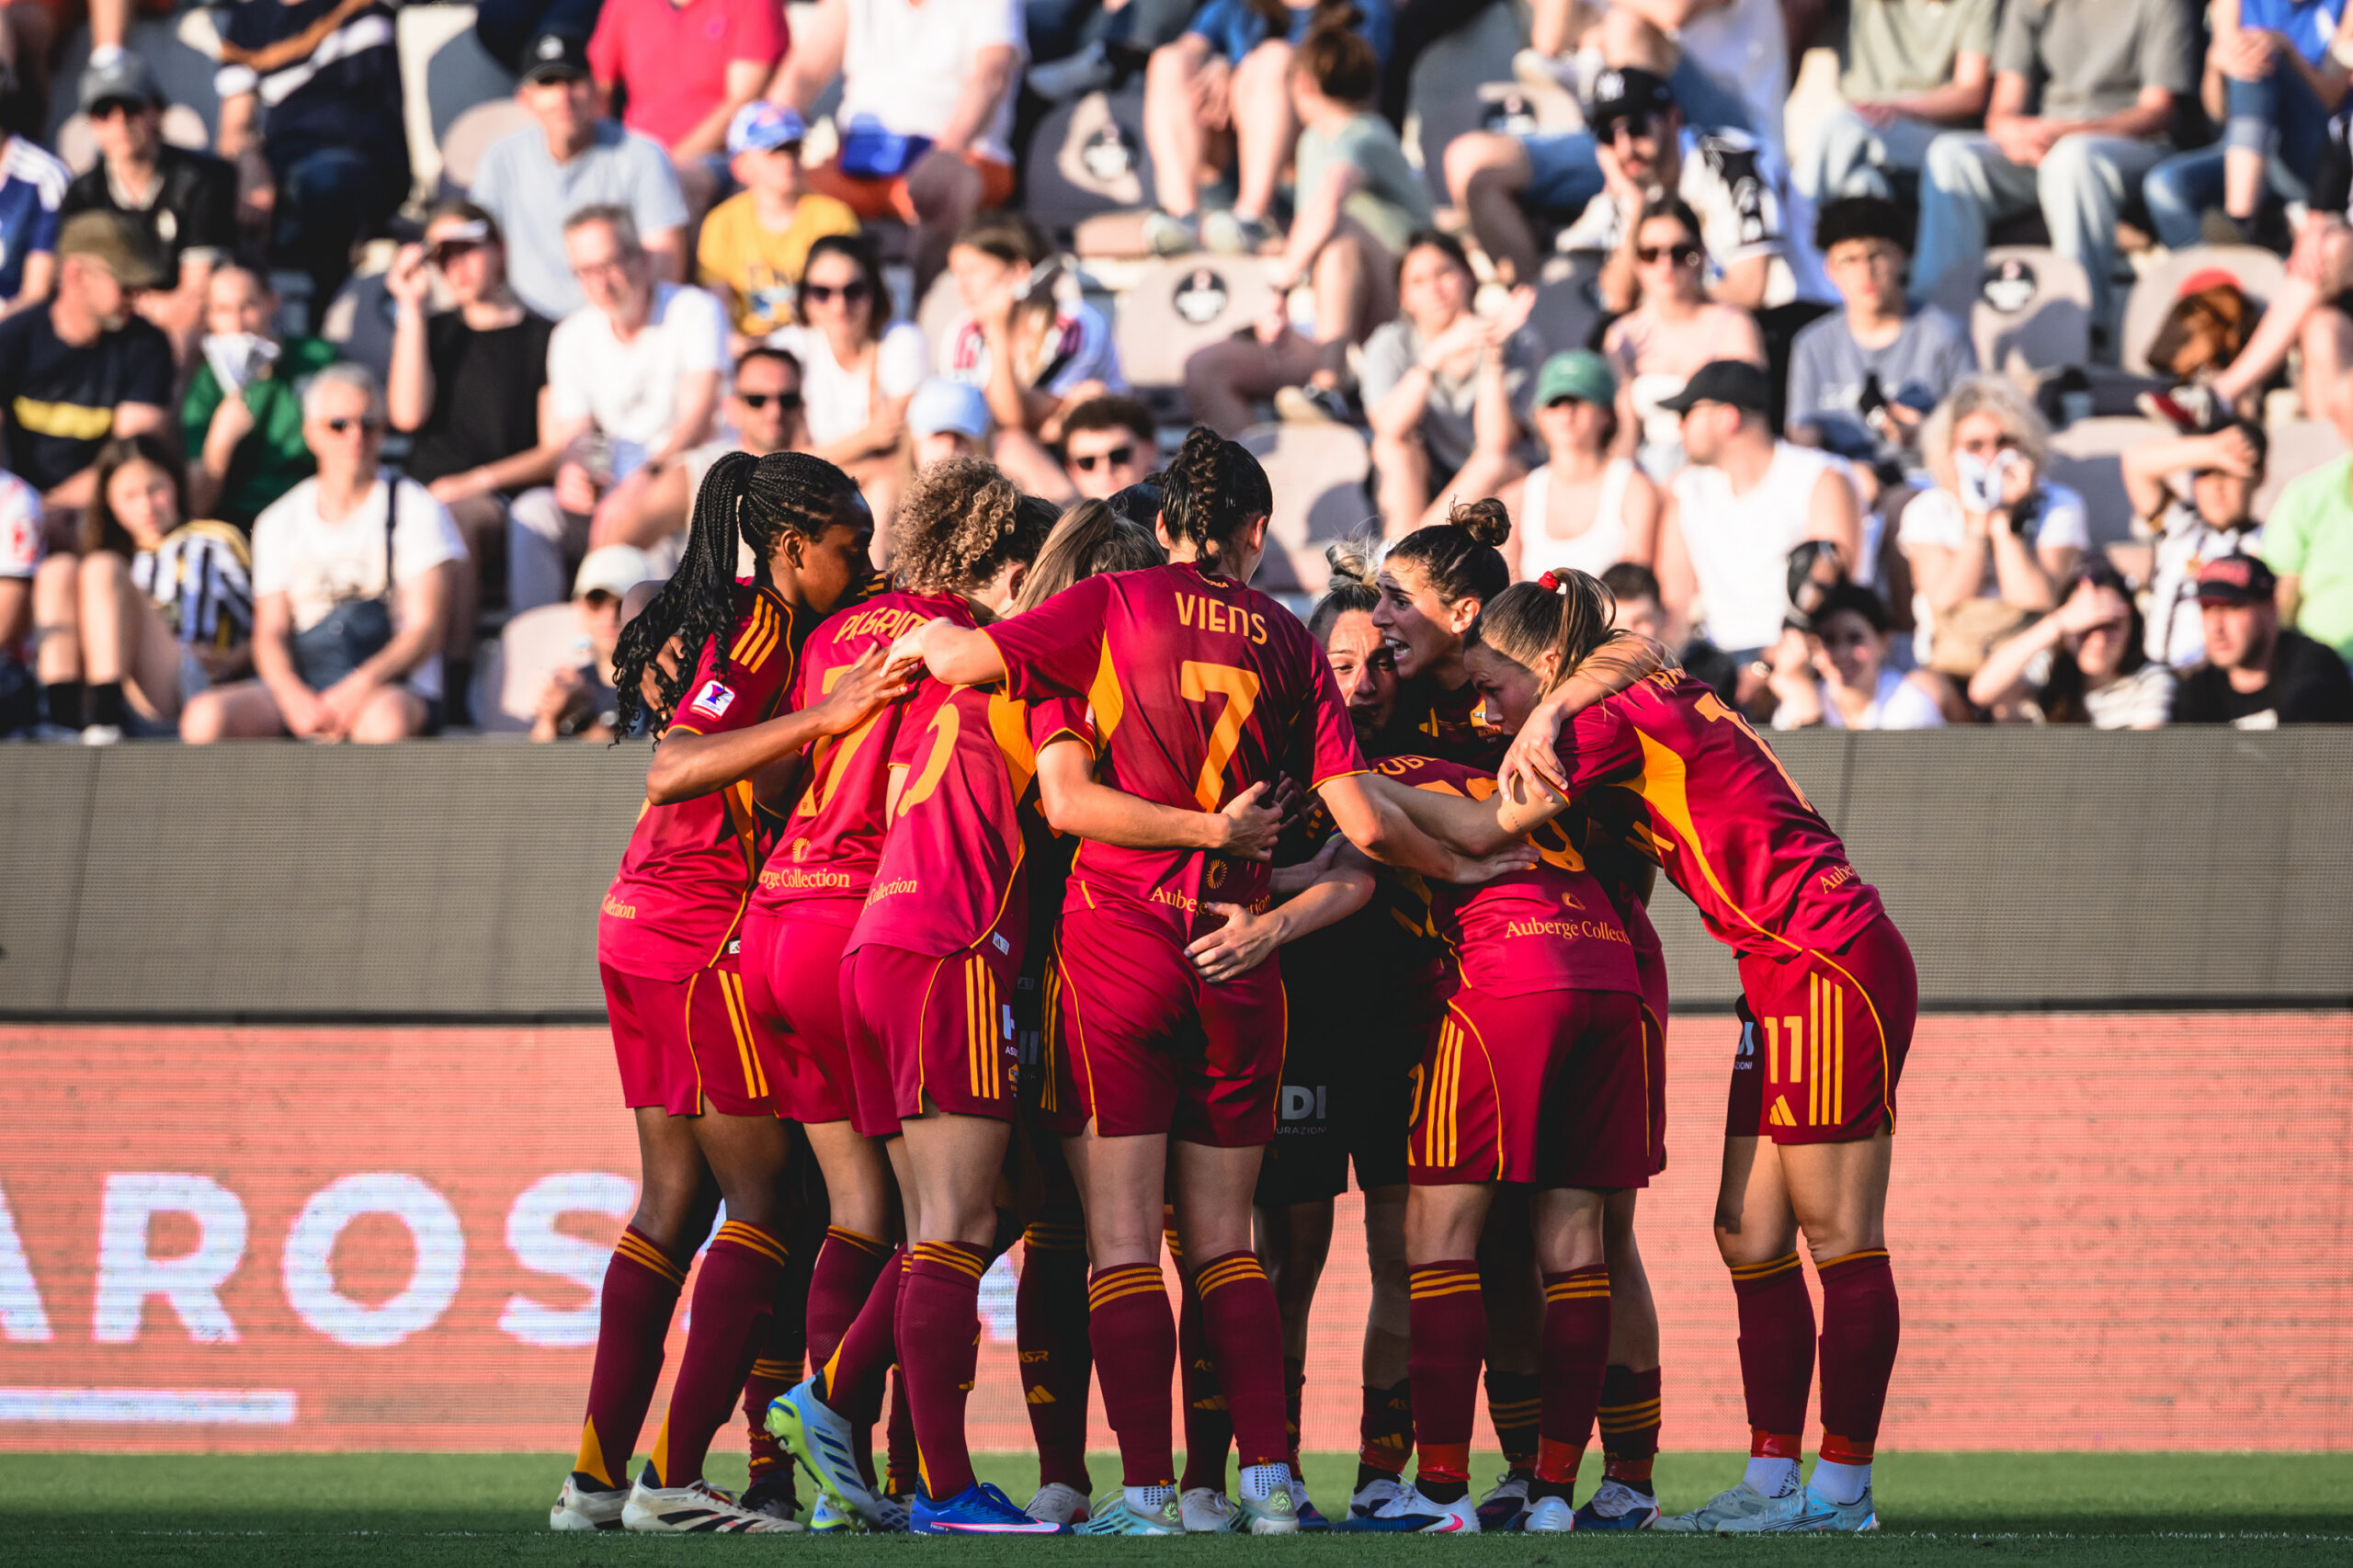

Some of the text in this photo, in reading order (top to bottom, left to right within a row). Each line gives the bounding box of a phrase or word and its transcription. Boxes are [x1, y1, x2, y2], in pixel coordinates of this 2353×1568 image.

[1175, 592, 1267, 645] VIENS
[1180, 660, 1260, 813] 7
[781, 868, 850, 888] Collection
[1505, 916, 1579, 940] Auberge
[1764, 1016, 1803, 1085] 11
[1281, 1085, 1327, 1120] DI
